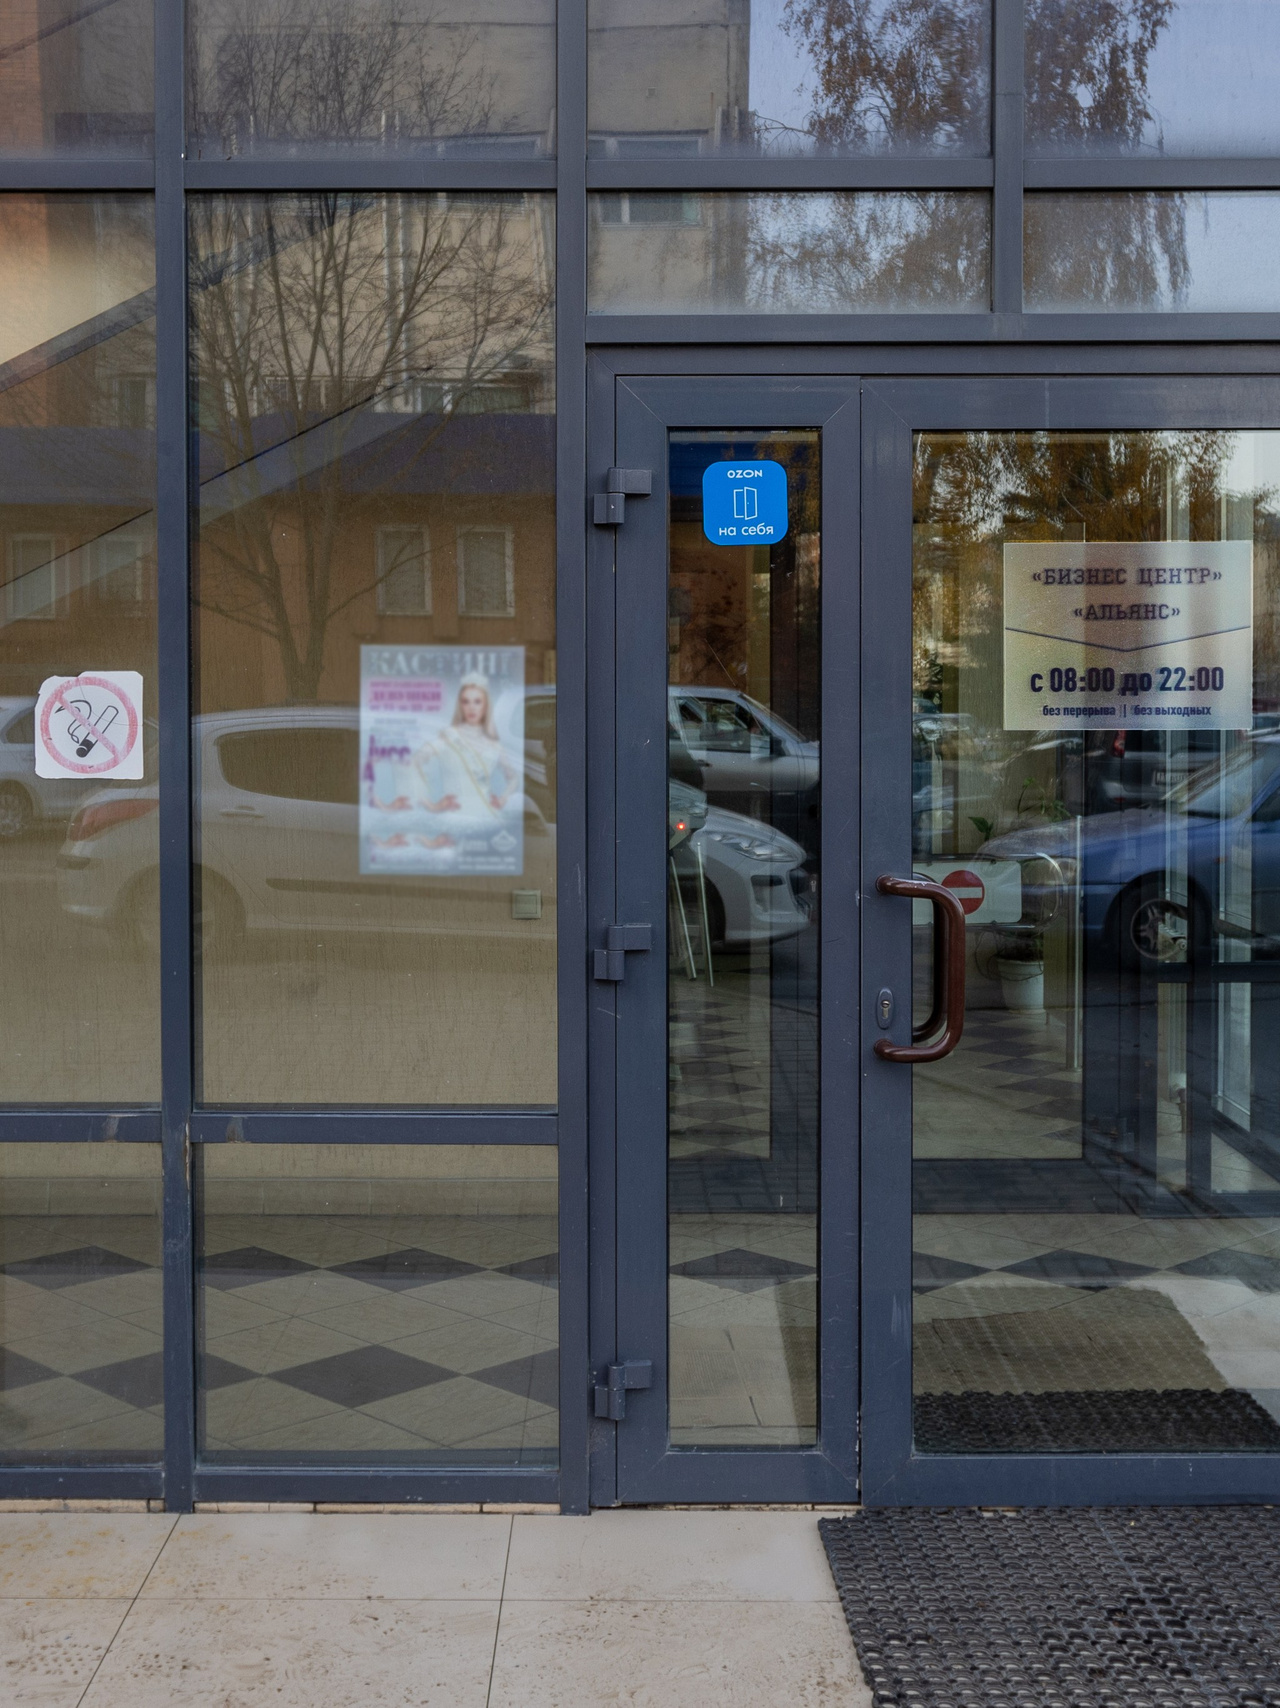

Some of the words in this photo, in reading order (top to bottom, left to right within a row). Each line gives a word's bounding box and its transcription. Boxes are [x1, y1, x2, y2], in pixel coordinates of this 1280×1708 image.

[727, 469, 762, 478] OZON
[719, 526, 737, 536] на
[741, 522, 774, 536] себя
[1032, 568, 1127, 585] «БИЗНЕС
[1137, 568, 1222, 587] ЦЕНТР»
[1073, 603, 1180, 620] «АЛЬЯНС»
[369, 652, 512, 675] КАСТИНГ
[1030, 673, 1043, 692] с
[1050, 667, 1115, 692] 08:00
[1120, 673, 1153, 696] до
[1159, 666, 1225, 692] 22:00
[1043, 704, 1061, 716] без
[1063, 706, 1116, 718] перерыва
[1134, 704, 1152, 716] без
[1155, 706, 1212, 718] выходных
